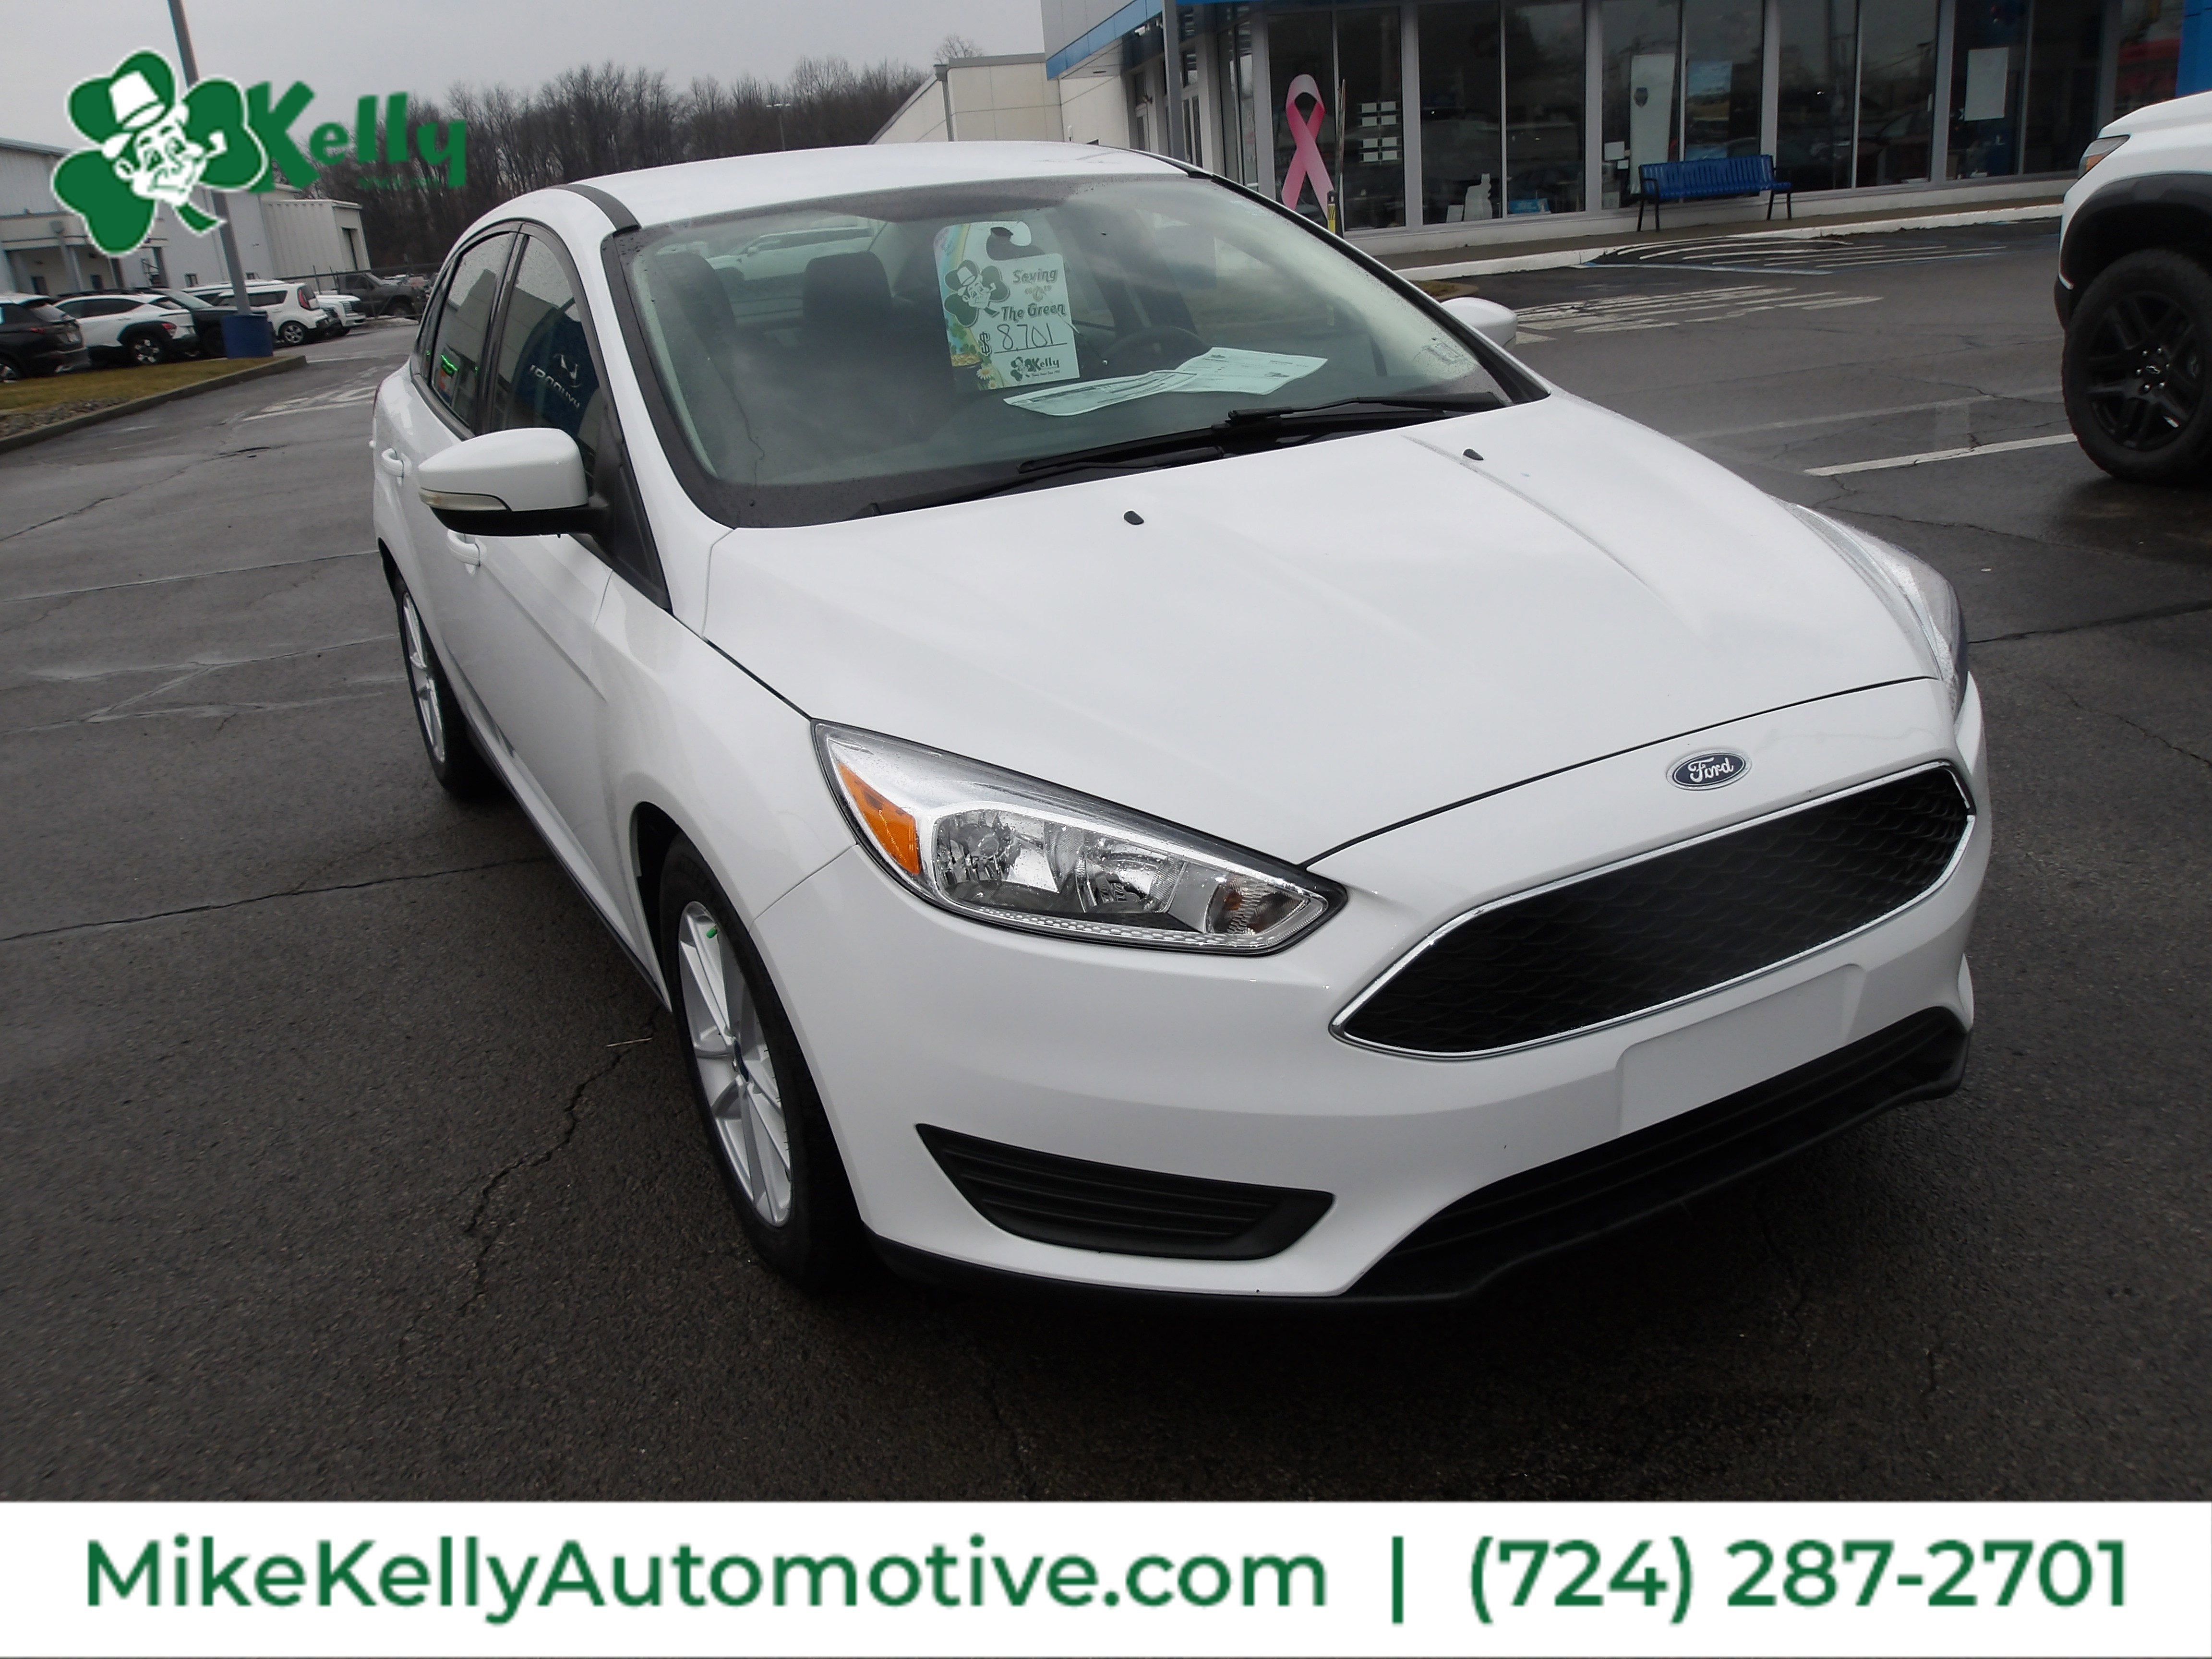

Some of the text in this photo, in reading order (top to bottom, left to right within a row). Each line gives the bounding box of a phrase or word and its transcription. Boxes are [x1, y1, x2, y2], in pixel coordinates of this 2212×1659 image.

[1001, 302, 1067, 323] The Green
[1031, 357, 1060, 372] Kelly
[1687, 757, 1734, 783] Ford
